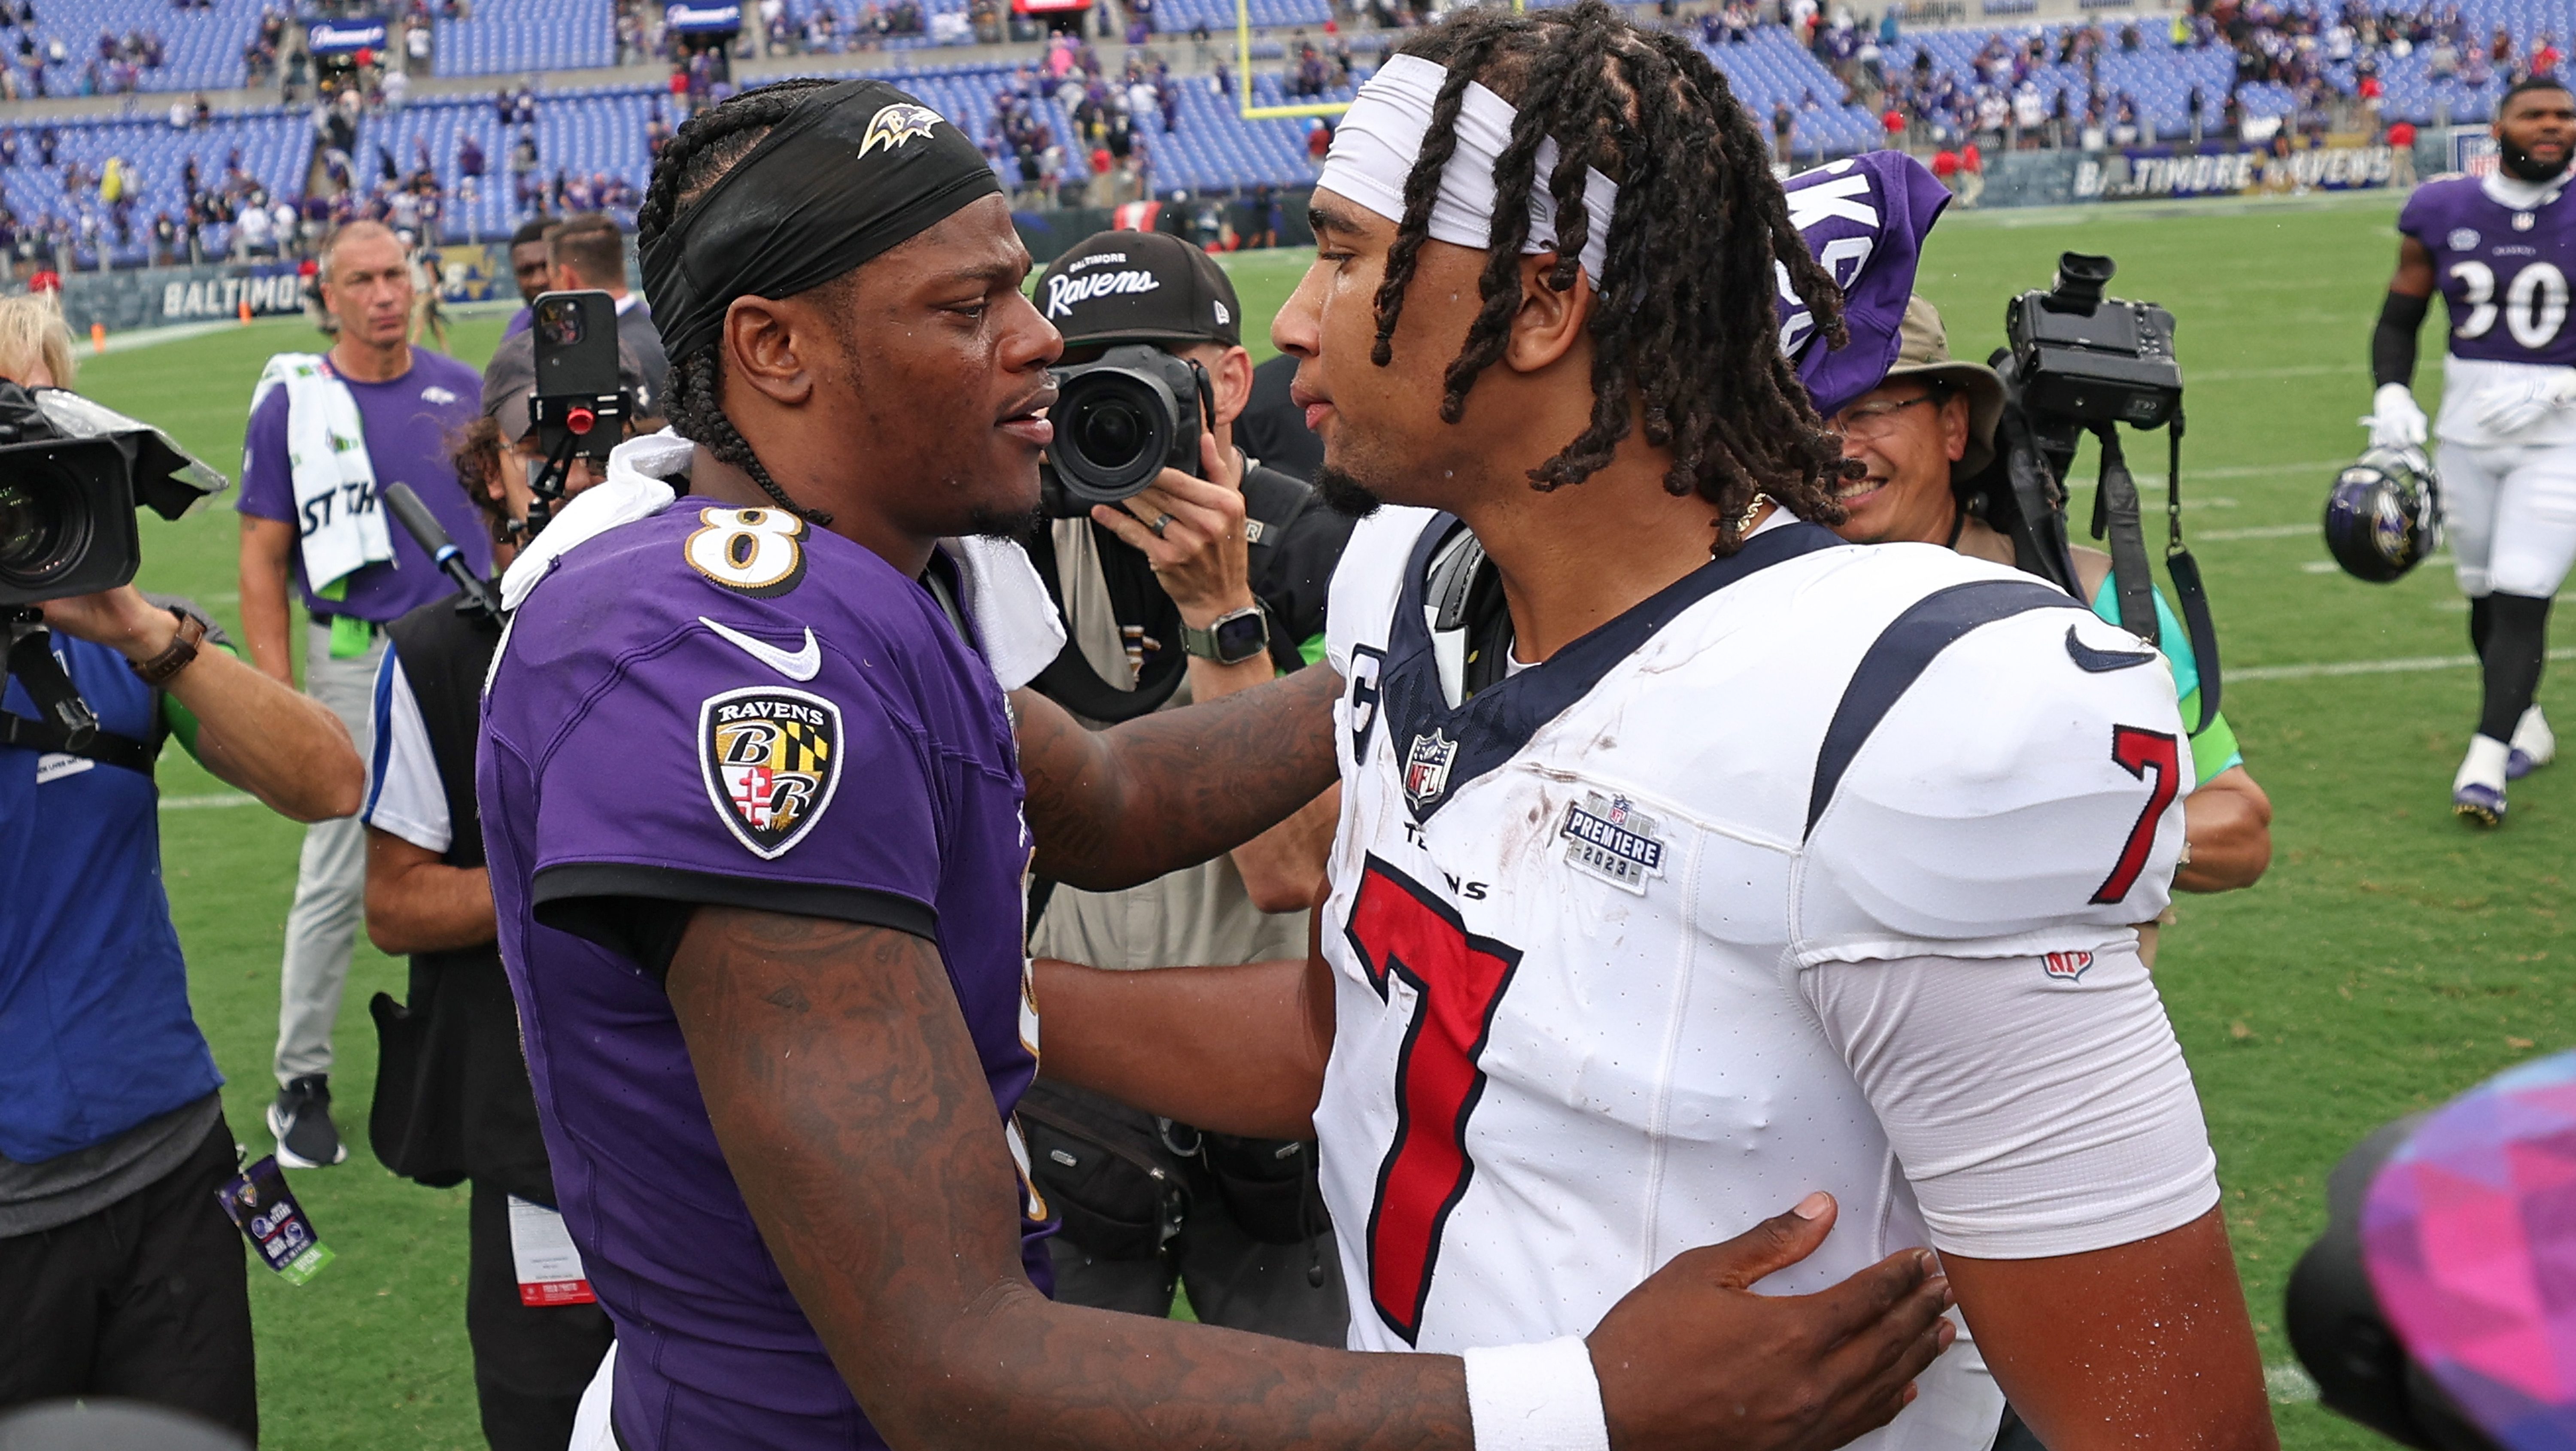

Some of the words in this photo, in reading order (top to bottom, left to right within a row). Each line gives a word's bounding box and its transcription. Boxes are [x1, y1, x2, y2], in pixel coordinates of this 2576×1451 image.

[1069, 253, 1126, 273] BALTIMORE
[163, 275, 304, 317] BALTIMO
[1047, 270, 1159, 319] Ravens
[2449, 261, 2569, 349] 30
[684, 505, 811, 598] 8
[718, 701, 824, 725] RAVENS
[1408, 764, 1436, 794] NFL
[2087, 724, 2179, 904] 7
[1584, 847, 1627, 876] 2023
[1344, 848, 1523, 1349] 7
